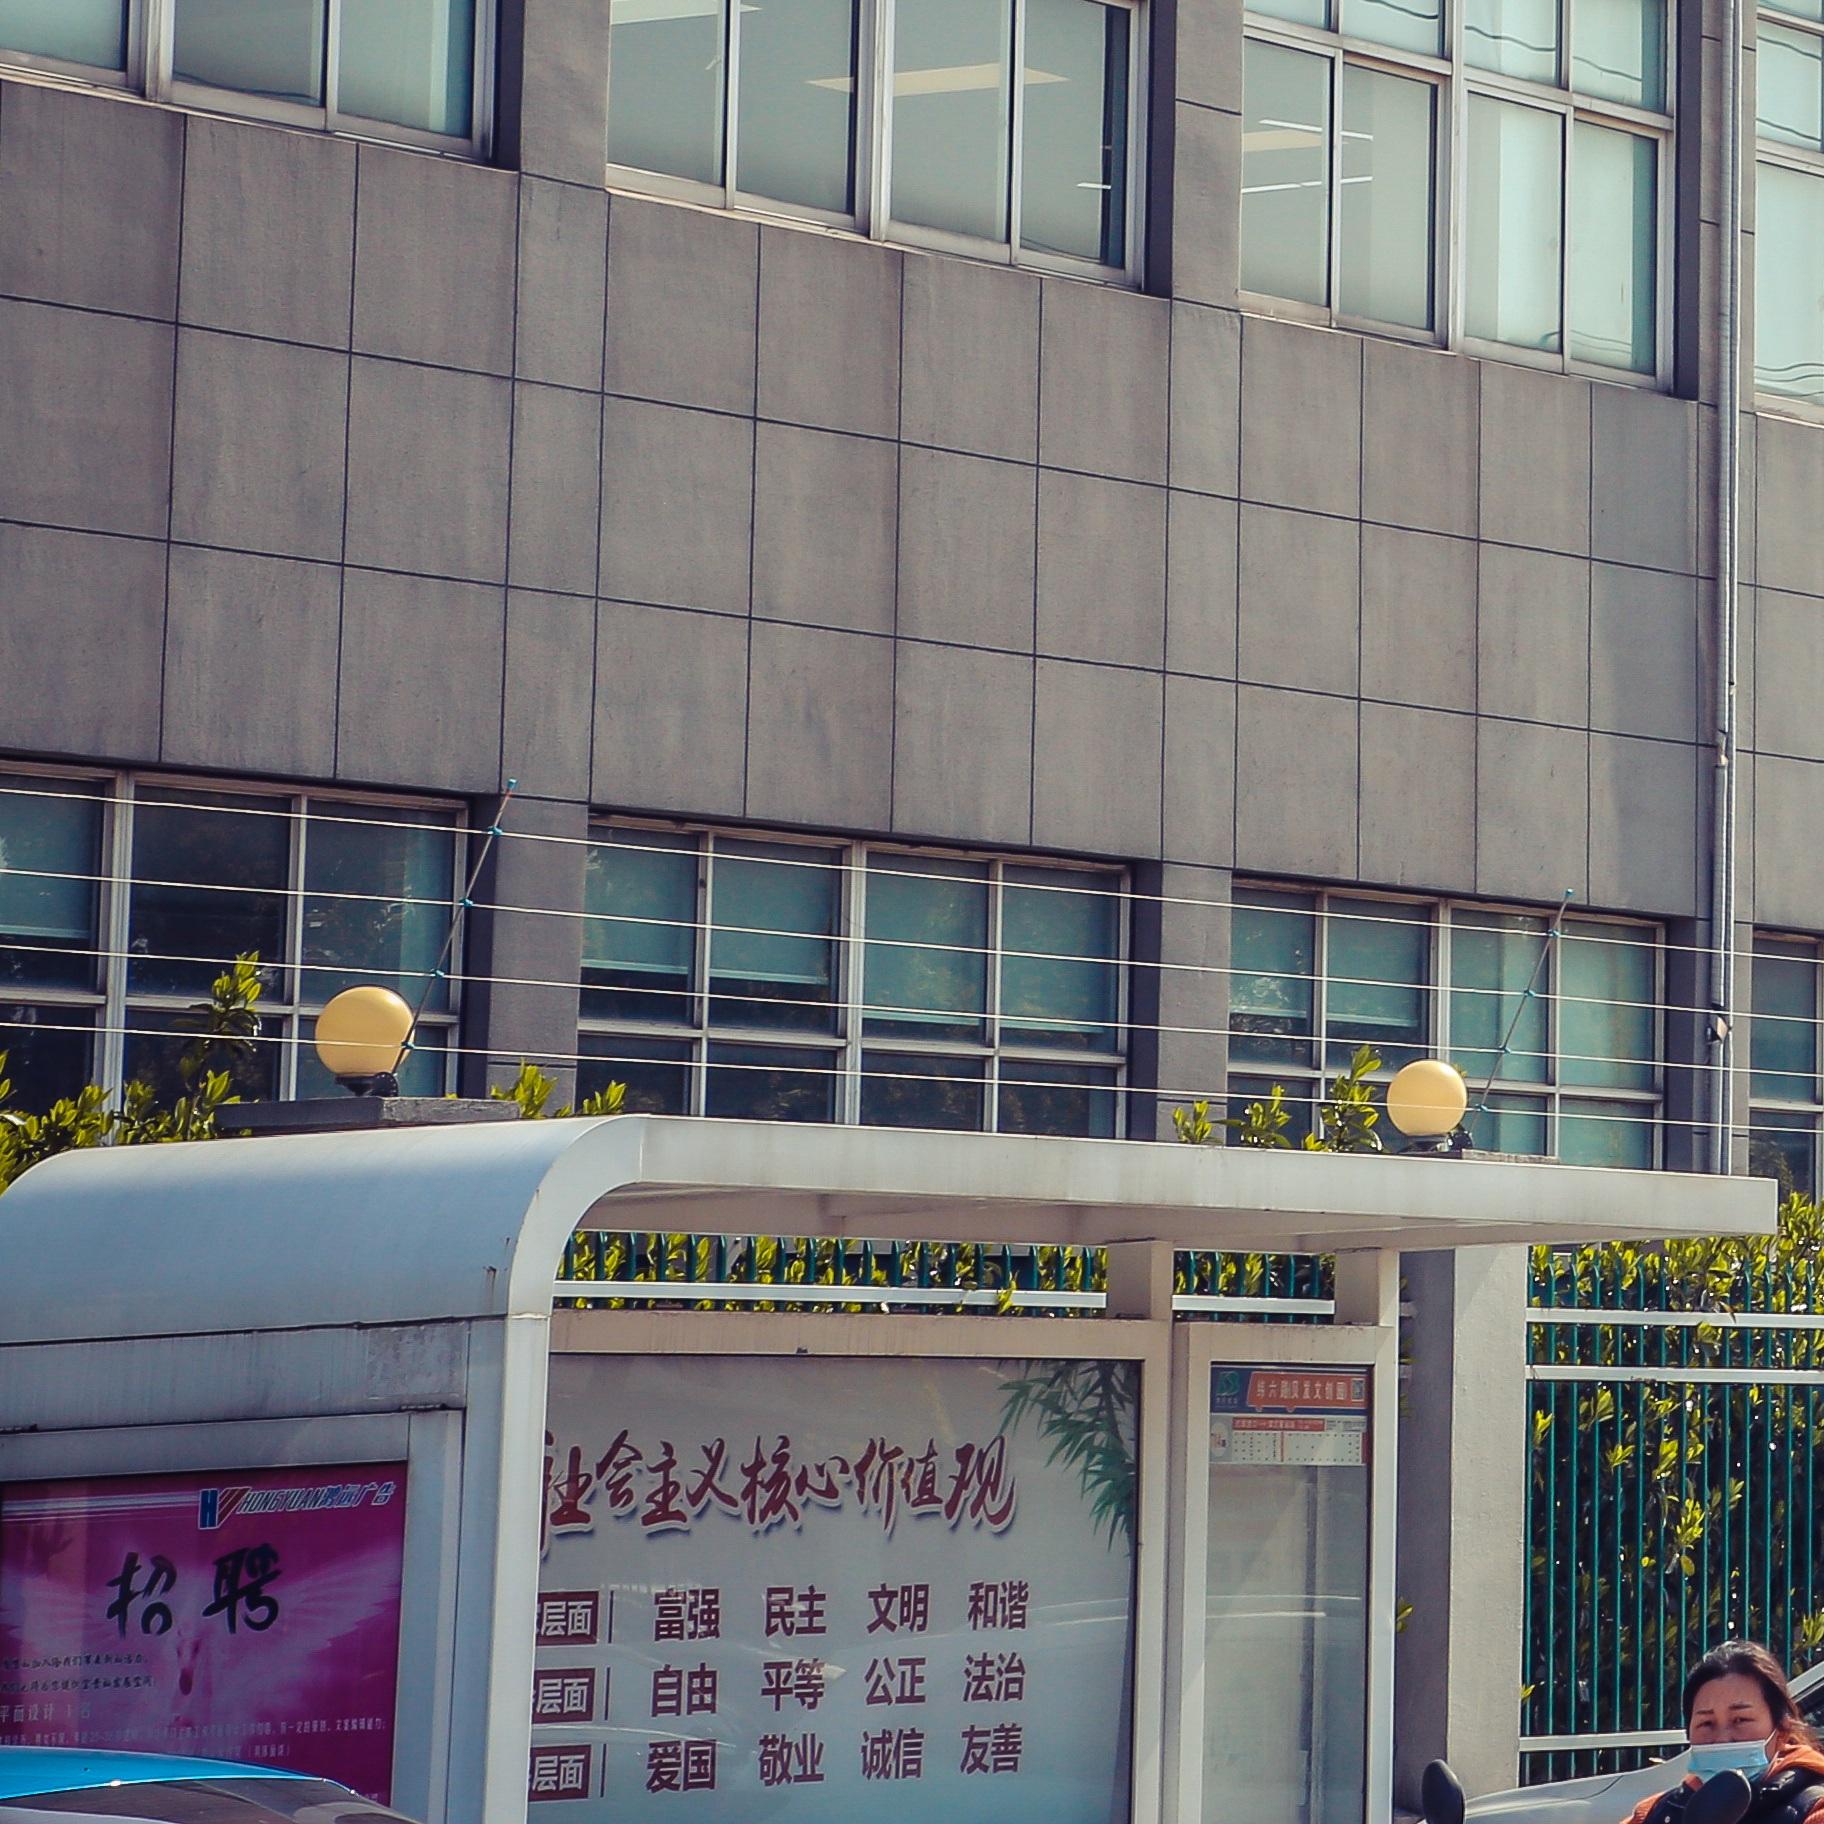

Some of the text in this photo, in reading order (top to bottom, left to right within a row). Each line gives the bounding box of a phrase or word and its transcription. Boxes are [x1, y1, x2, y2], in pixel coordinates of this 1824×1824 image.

[540, 1429, 1016, 1551] 社会主义核心价值观
[105, 1542, 283, 1640] 招聘
[535, 1580, 1029, 1642] 层面 富强 民主 文明 和谐
[532, 1651, 1026, 1718] 层面 自由 平等 公正 法治
[528, 1721, 1023, 1794] 层面 爱国 敬业 诚信 友善
